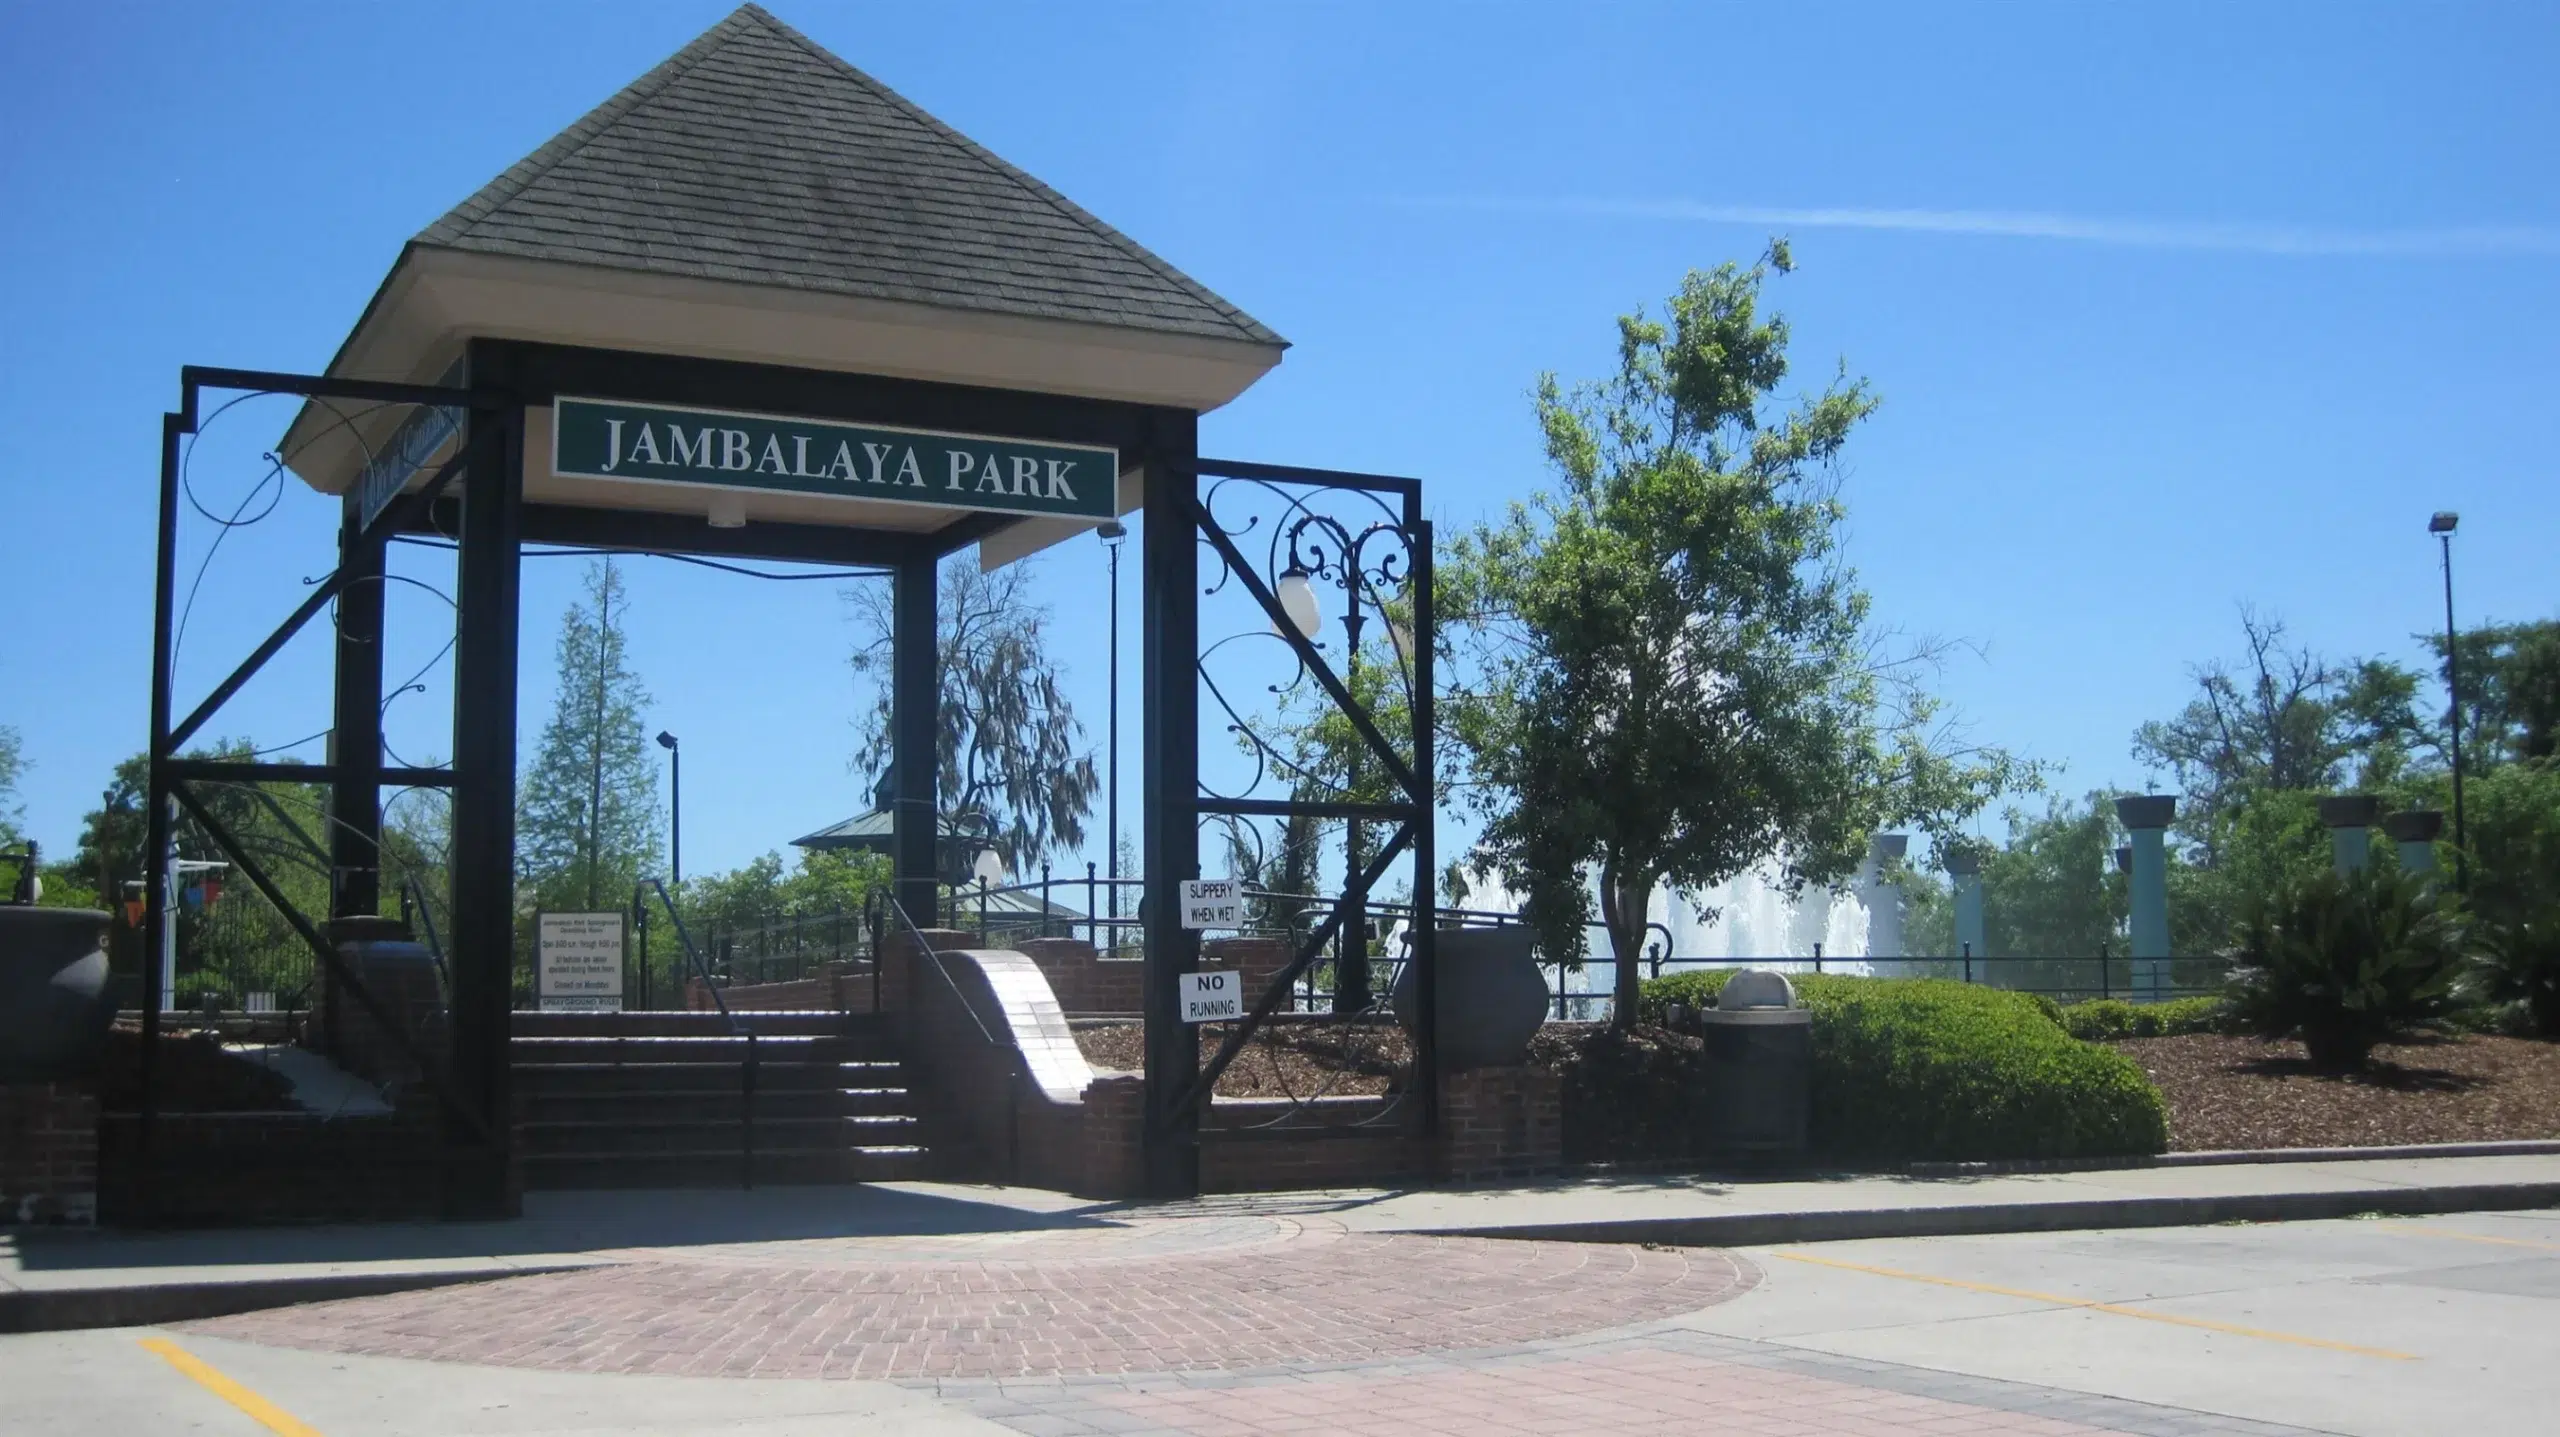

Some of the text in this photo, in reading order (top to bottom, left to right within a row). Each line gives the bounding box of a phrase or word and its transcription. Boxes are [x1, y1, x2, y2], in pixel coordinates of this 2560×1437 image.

[602, 419, 1078, 500] JAMBALAYA PARK
[1190, 883, 1234, 899] SLIPPERY
[1190, 906, 1234, 922] WHEN WET
[1198, 976, 1224, 990] NO
[1190, 1000, 1235, 1017] RUNNING
